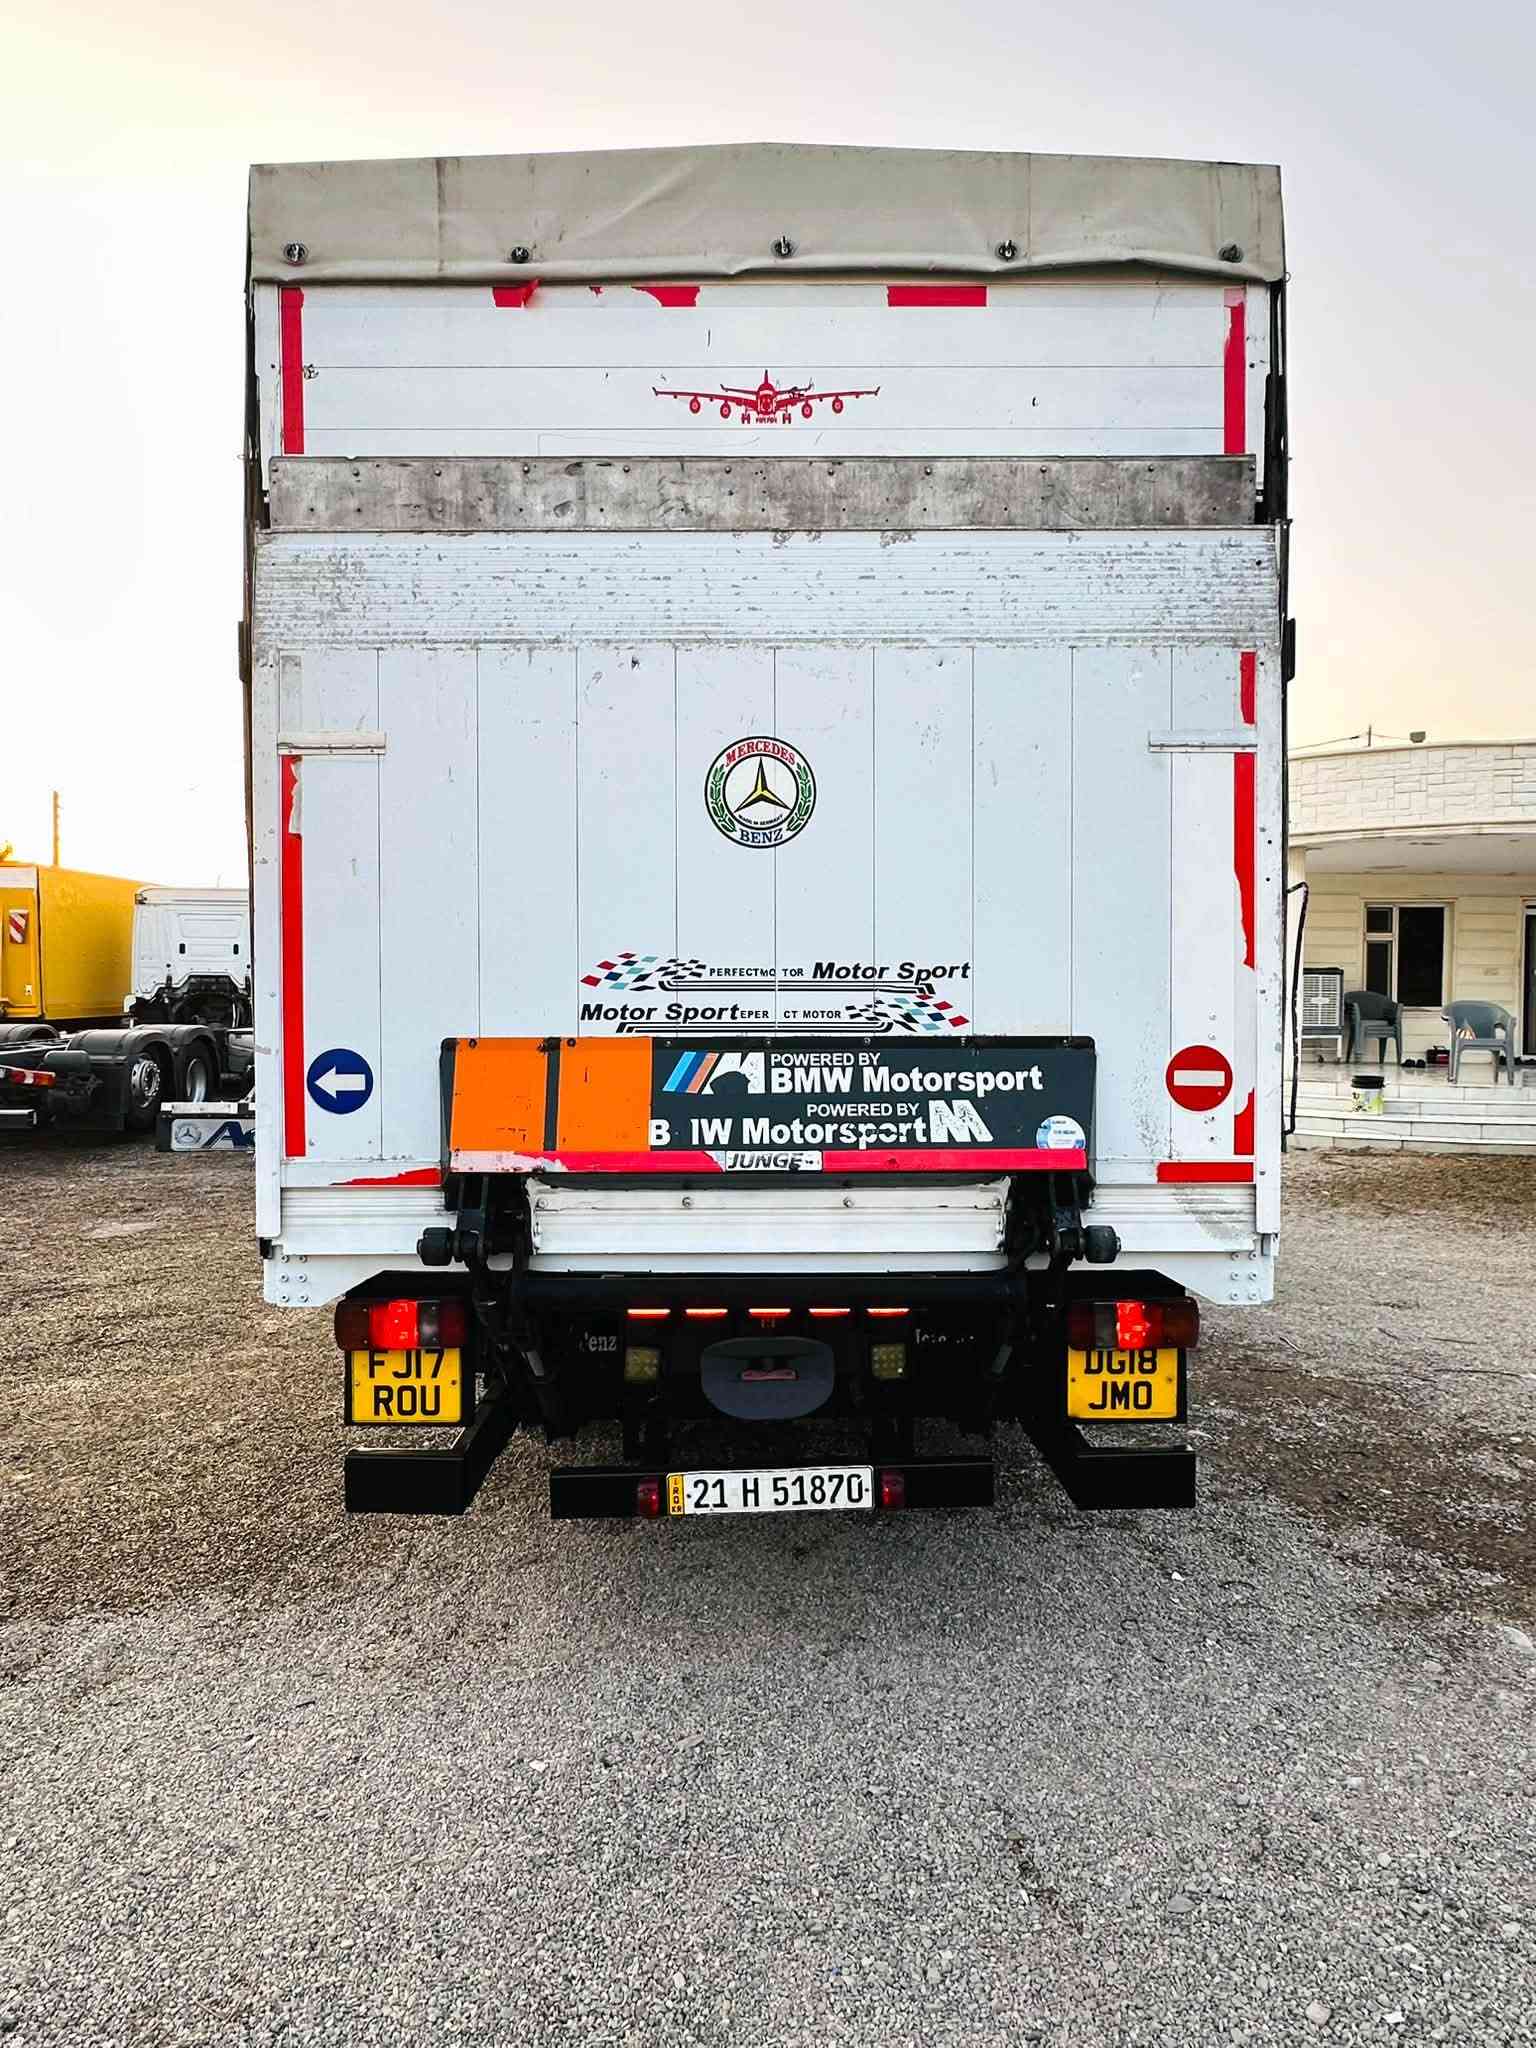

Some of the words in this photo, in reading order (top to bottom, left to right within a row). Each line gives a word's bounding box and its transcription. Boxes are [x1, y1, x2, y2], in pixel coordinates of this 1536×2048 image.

[725, 740, 796, 767] MERCEDES
[739, 828, 784, 844] BENZ
[812, 962, 890, 979] Motor
[897, 962, 971, 985] Sport
[580, 1003, 658, 1020] Motor
[665, 1003, 740, 1024] Sport
[803, 1010, 842, 1019] MOTOR
[771, 1053, 854, 1066] POWERED
[859, 1053, 880, 1066] BY
[771, 1067, 853, 1094] BMW
[863, 1065, 1043, 1098] Motorsport
[807, 1103, 892, 1117] POWERED
[896, 1102, 920, 1116] BY
[743, 1116, 927, 1150] Motorsport
[728, 1152, 804, 1170] JUNGE
[581, 1329, 617, 1352] enz
[369, 1350, 445, 1379] FJ17
[374, 1385, 441, 1417] ROU
[1088, 1381, 1153, 1410] JMO
[693, 1479, 728, 1508] 21
[742, 1477, 760, 1507] H
[772, 1473, 864, 1506] 51870
